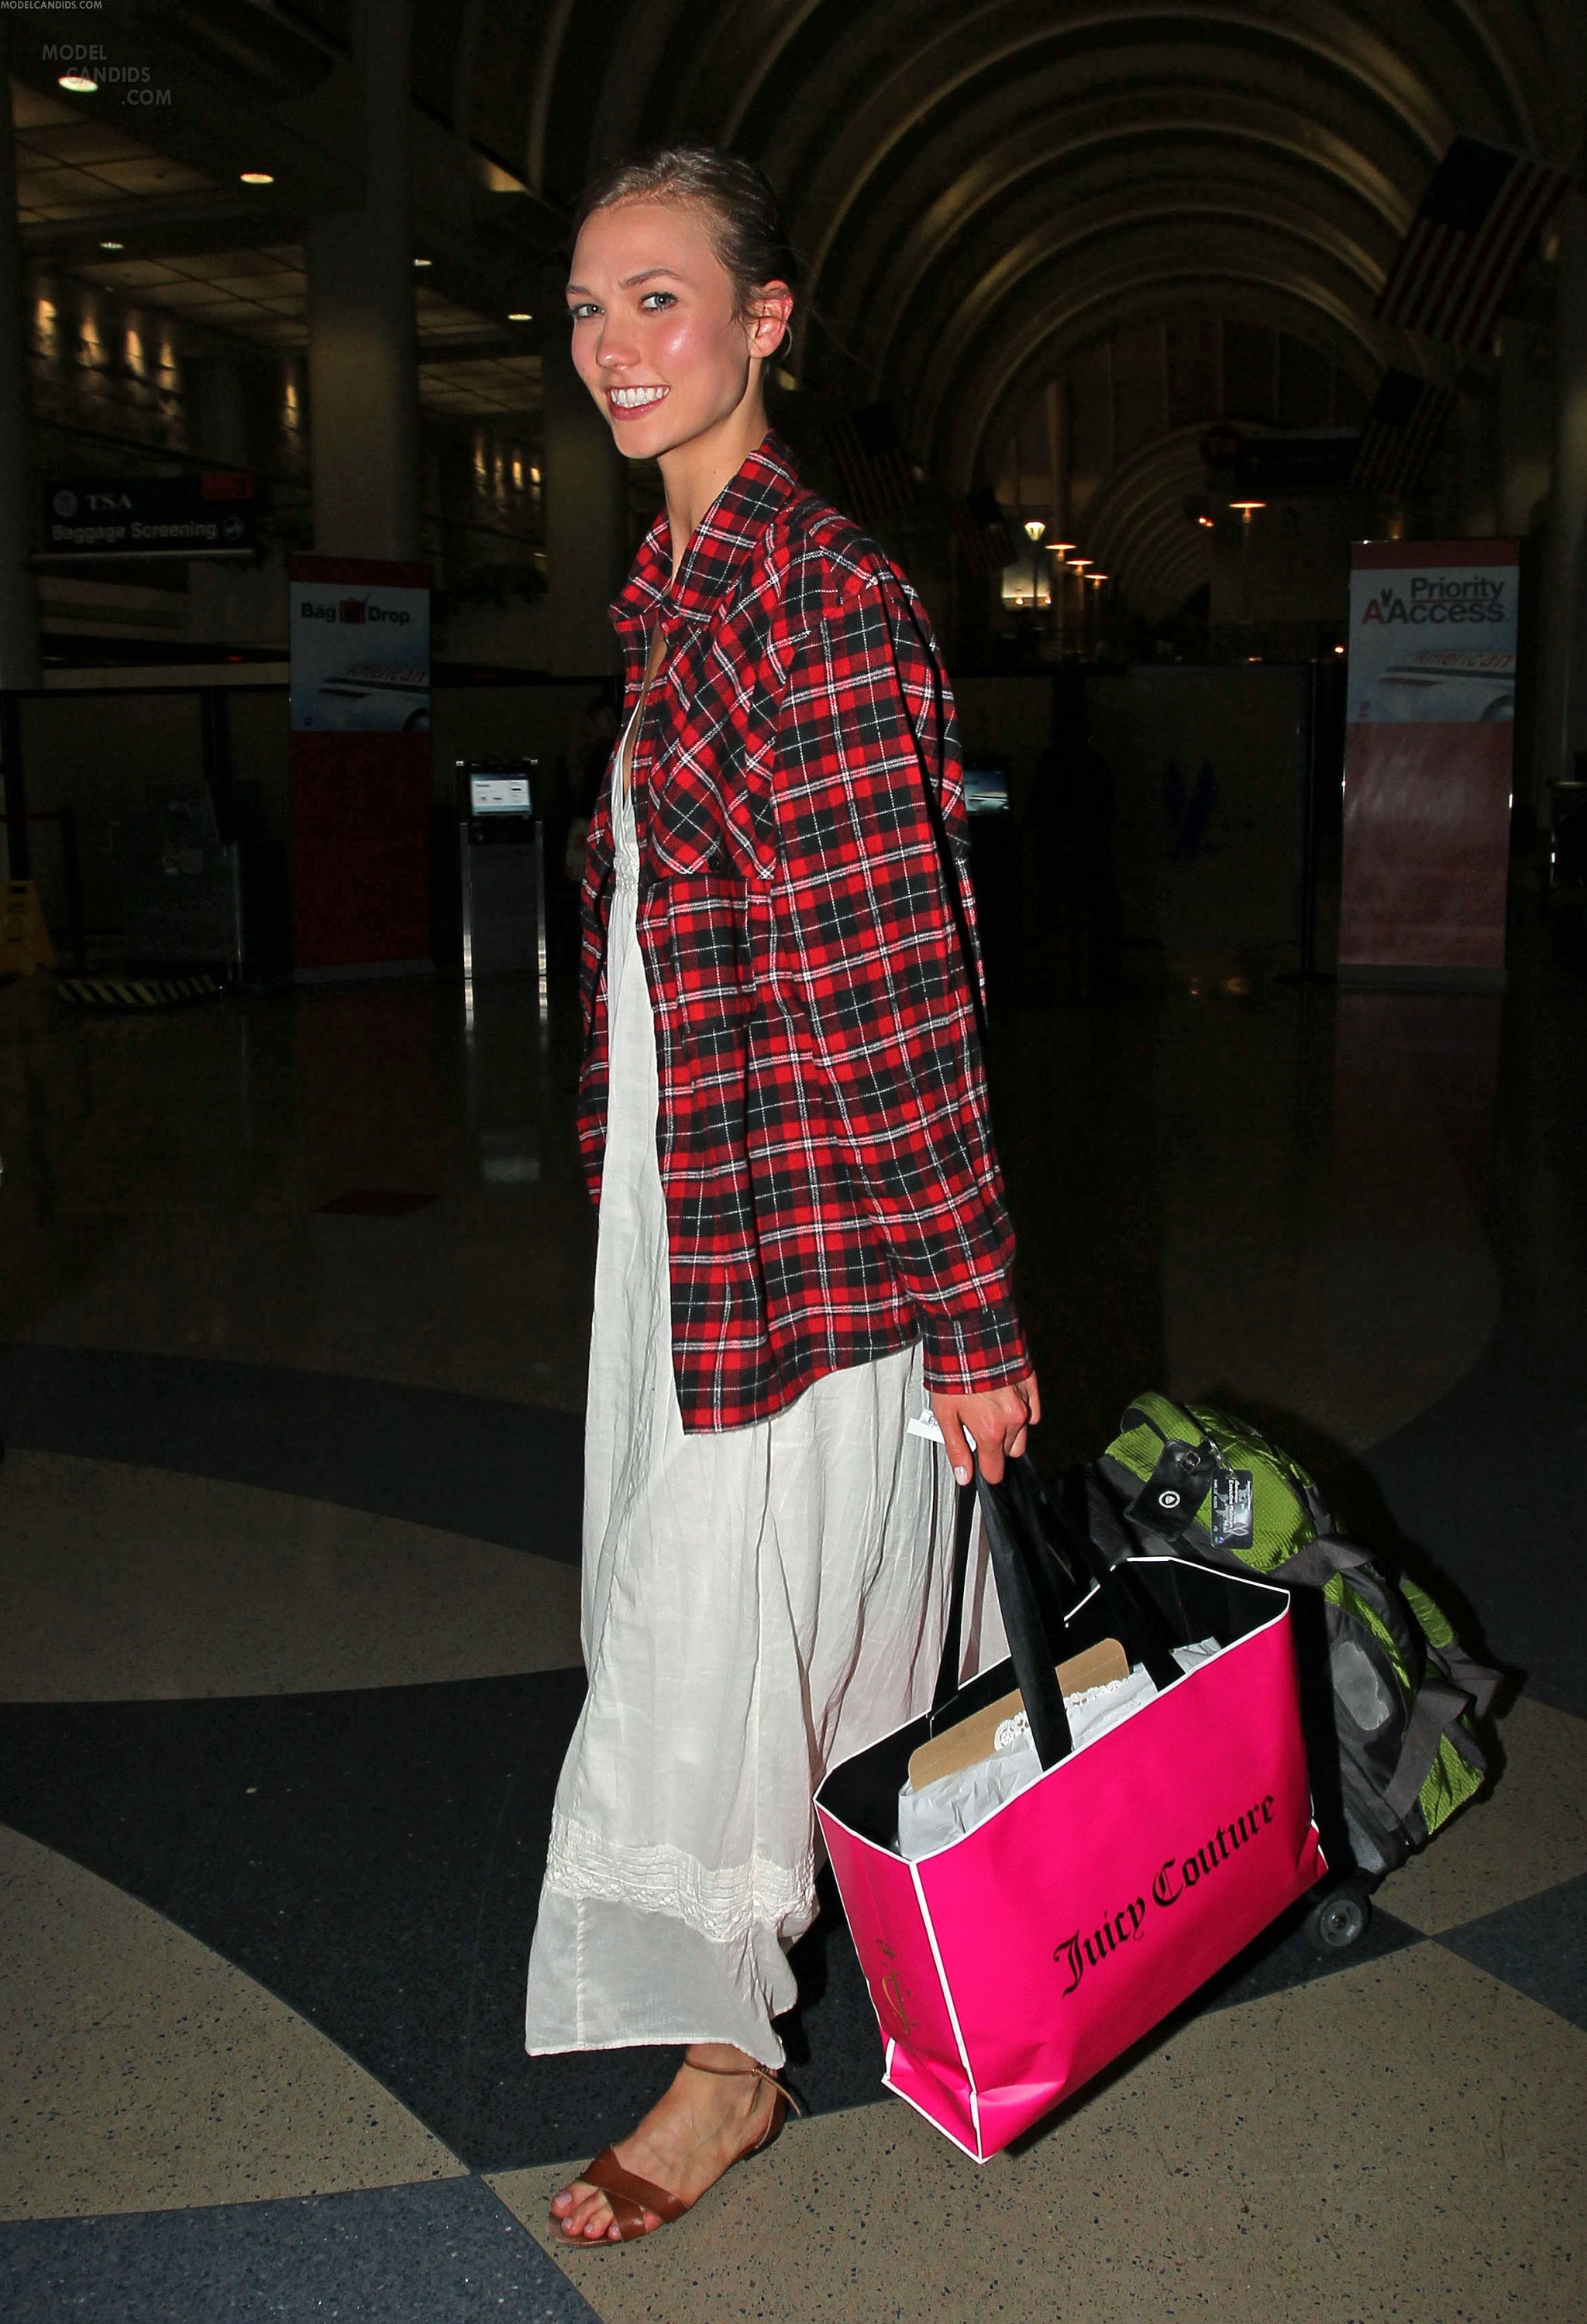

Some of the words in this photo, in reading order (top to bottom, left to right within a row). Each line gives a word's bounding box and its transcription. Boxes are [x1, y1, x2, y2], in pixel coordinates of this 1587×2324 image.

[84, 493, 133, 511] TSA
[51, 524, 126, 543] Baggage
[130, 519, 217, 540] Screening
[1410, 576, 1504, 601] Priority
[301, 602, 336, 622] Bag
[368, 606, 411, 626] Drop
[1053, 1896, 1145, 1999] Juicy
[1152, 1795, 1274, 1907] Couture
